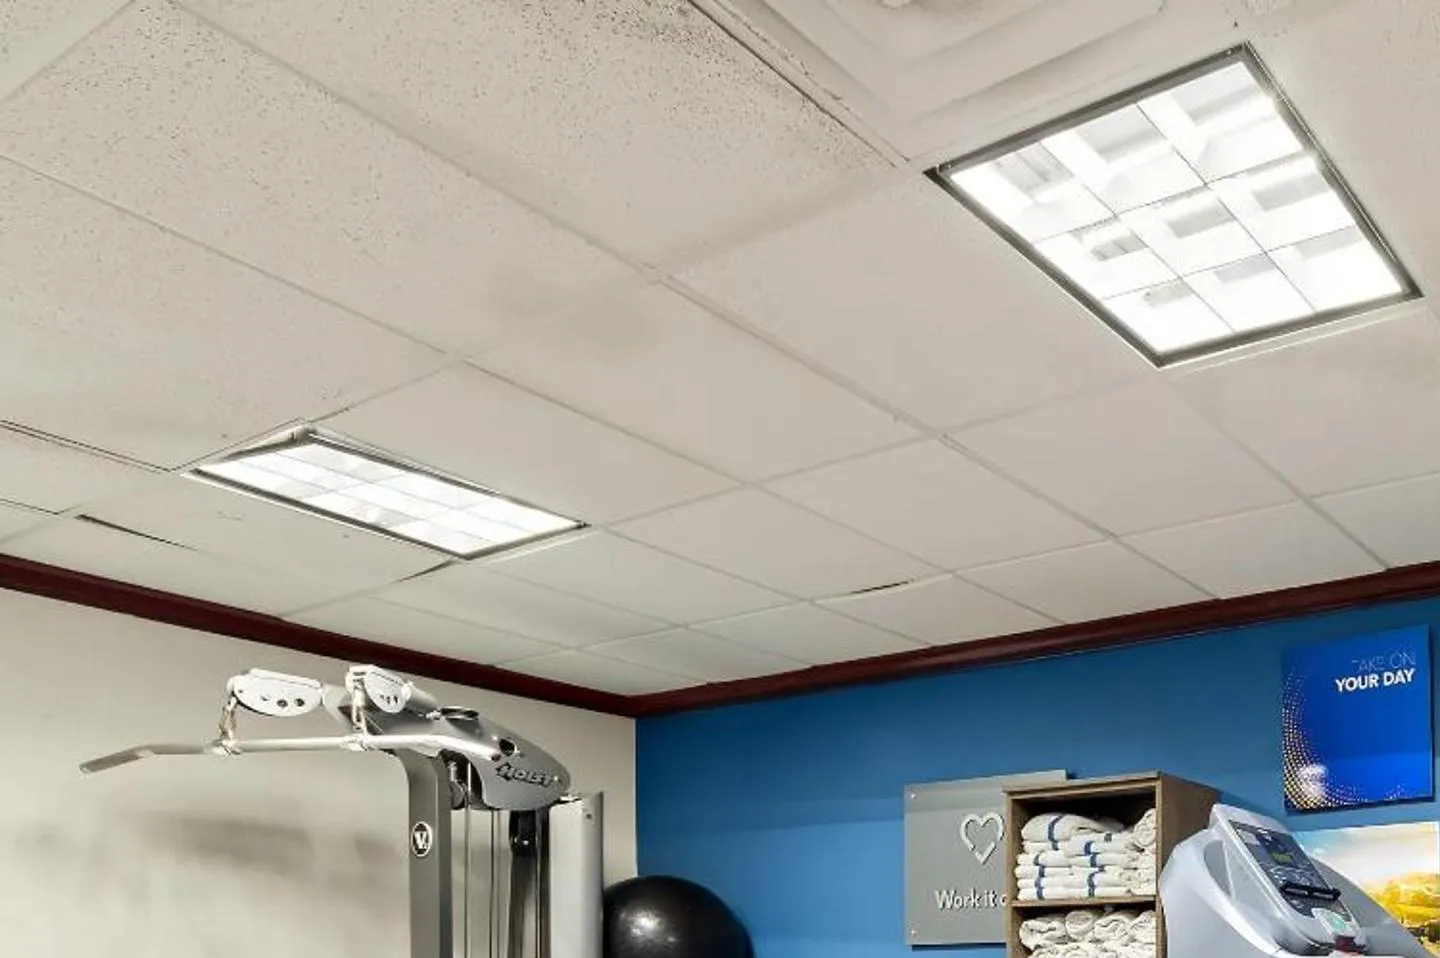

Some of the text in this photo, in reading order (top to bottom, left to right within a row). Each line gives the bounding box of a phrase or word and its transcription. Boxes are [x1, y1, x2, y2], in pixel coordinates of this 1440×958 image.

[1335, 668, 1416, 692] YOUR DAY
[934, 888, 981, 909] Work
[984, 890, 998, 908] it
